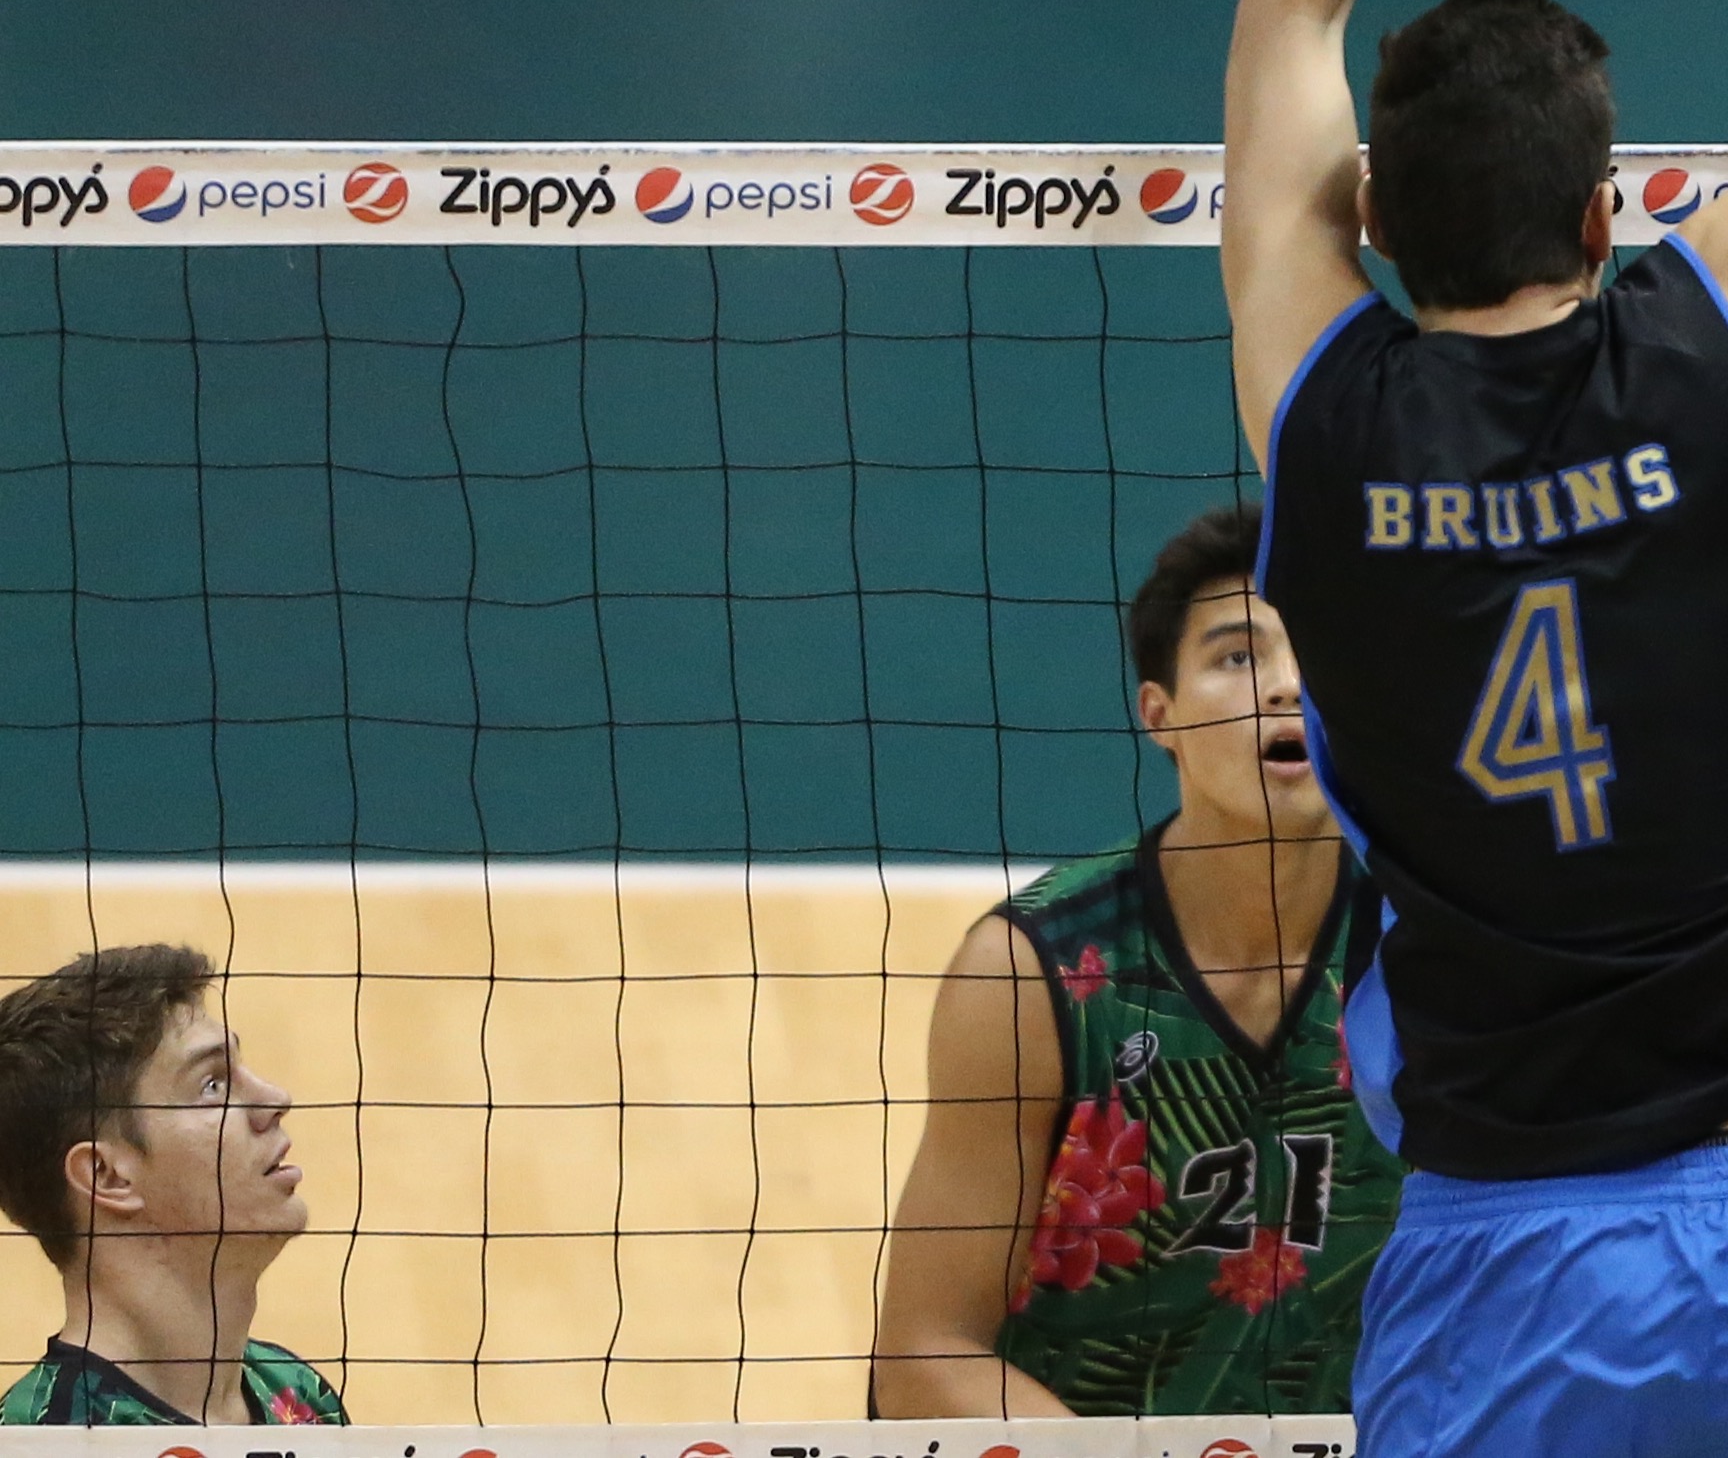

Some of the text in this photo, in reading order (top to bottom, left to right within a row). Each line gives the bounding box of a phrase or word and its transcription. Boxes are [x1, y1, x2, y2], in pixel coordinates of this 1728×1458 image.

[199, 173, 325, 217] pepsi
[440, 163, 616, 228] Zippy's
[706, 175, 832, 219] pepsi
[945, 164, 1121, 230] Zippy's
[1364, 442, 1681, 550] BRUINS
[1455, 577, 1616, 853] 4
[1160, 1133, 1334, 1258] 21
